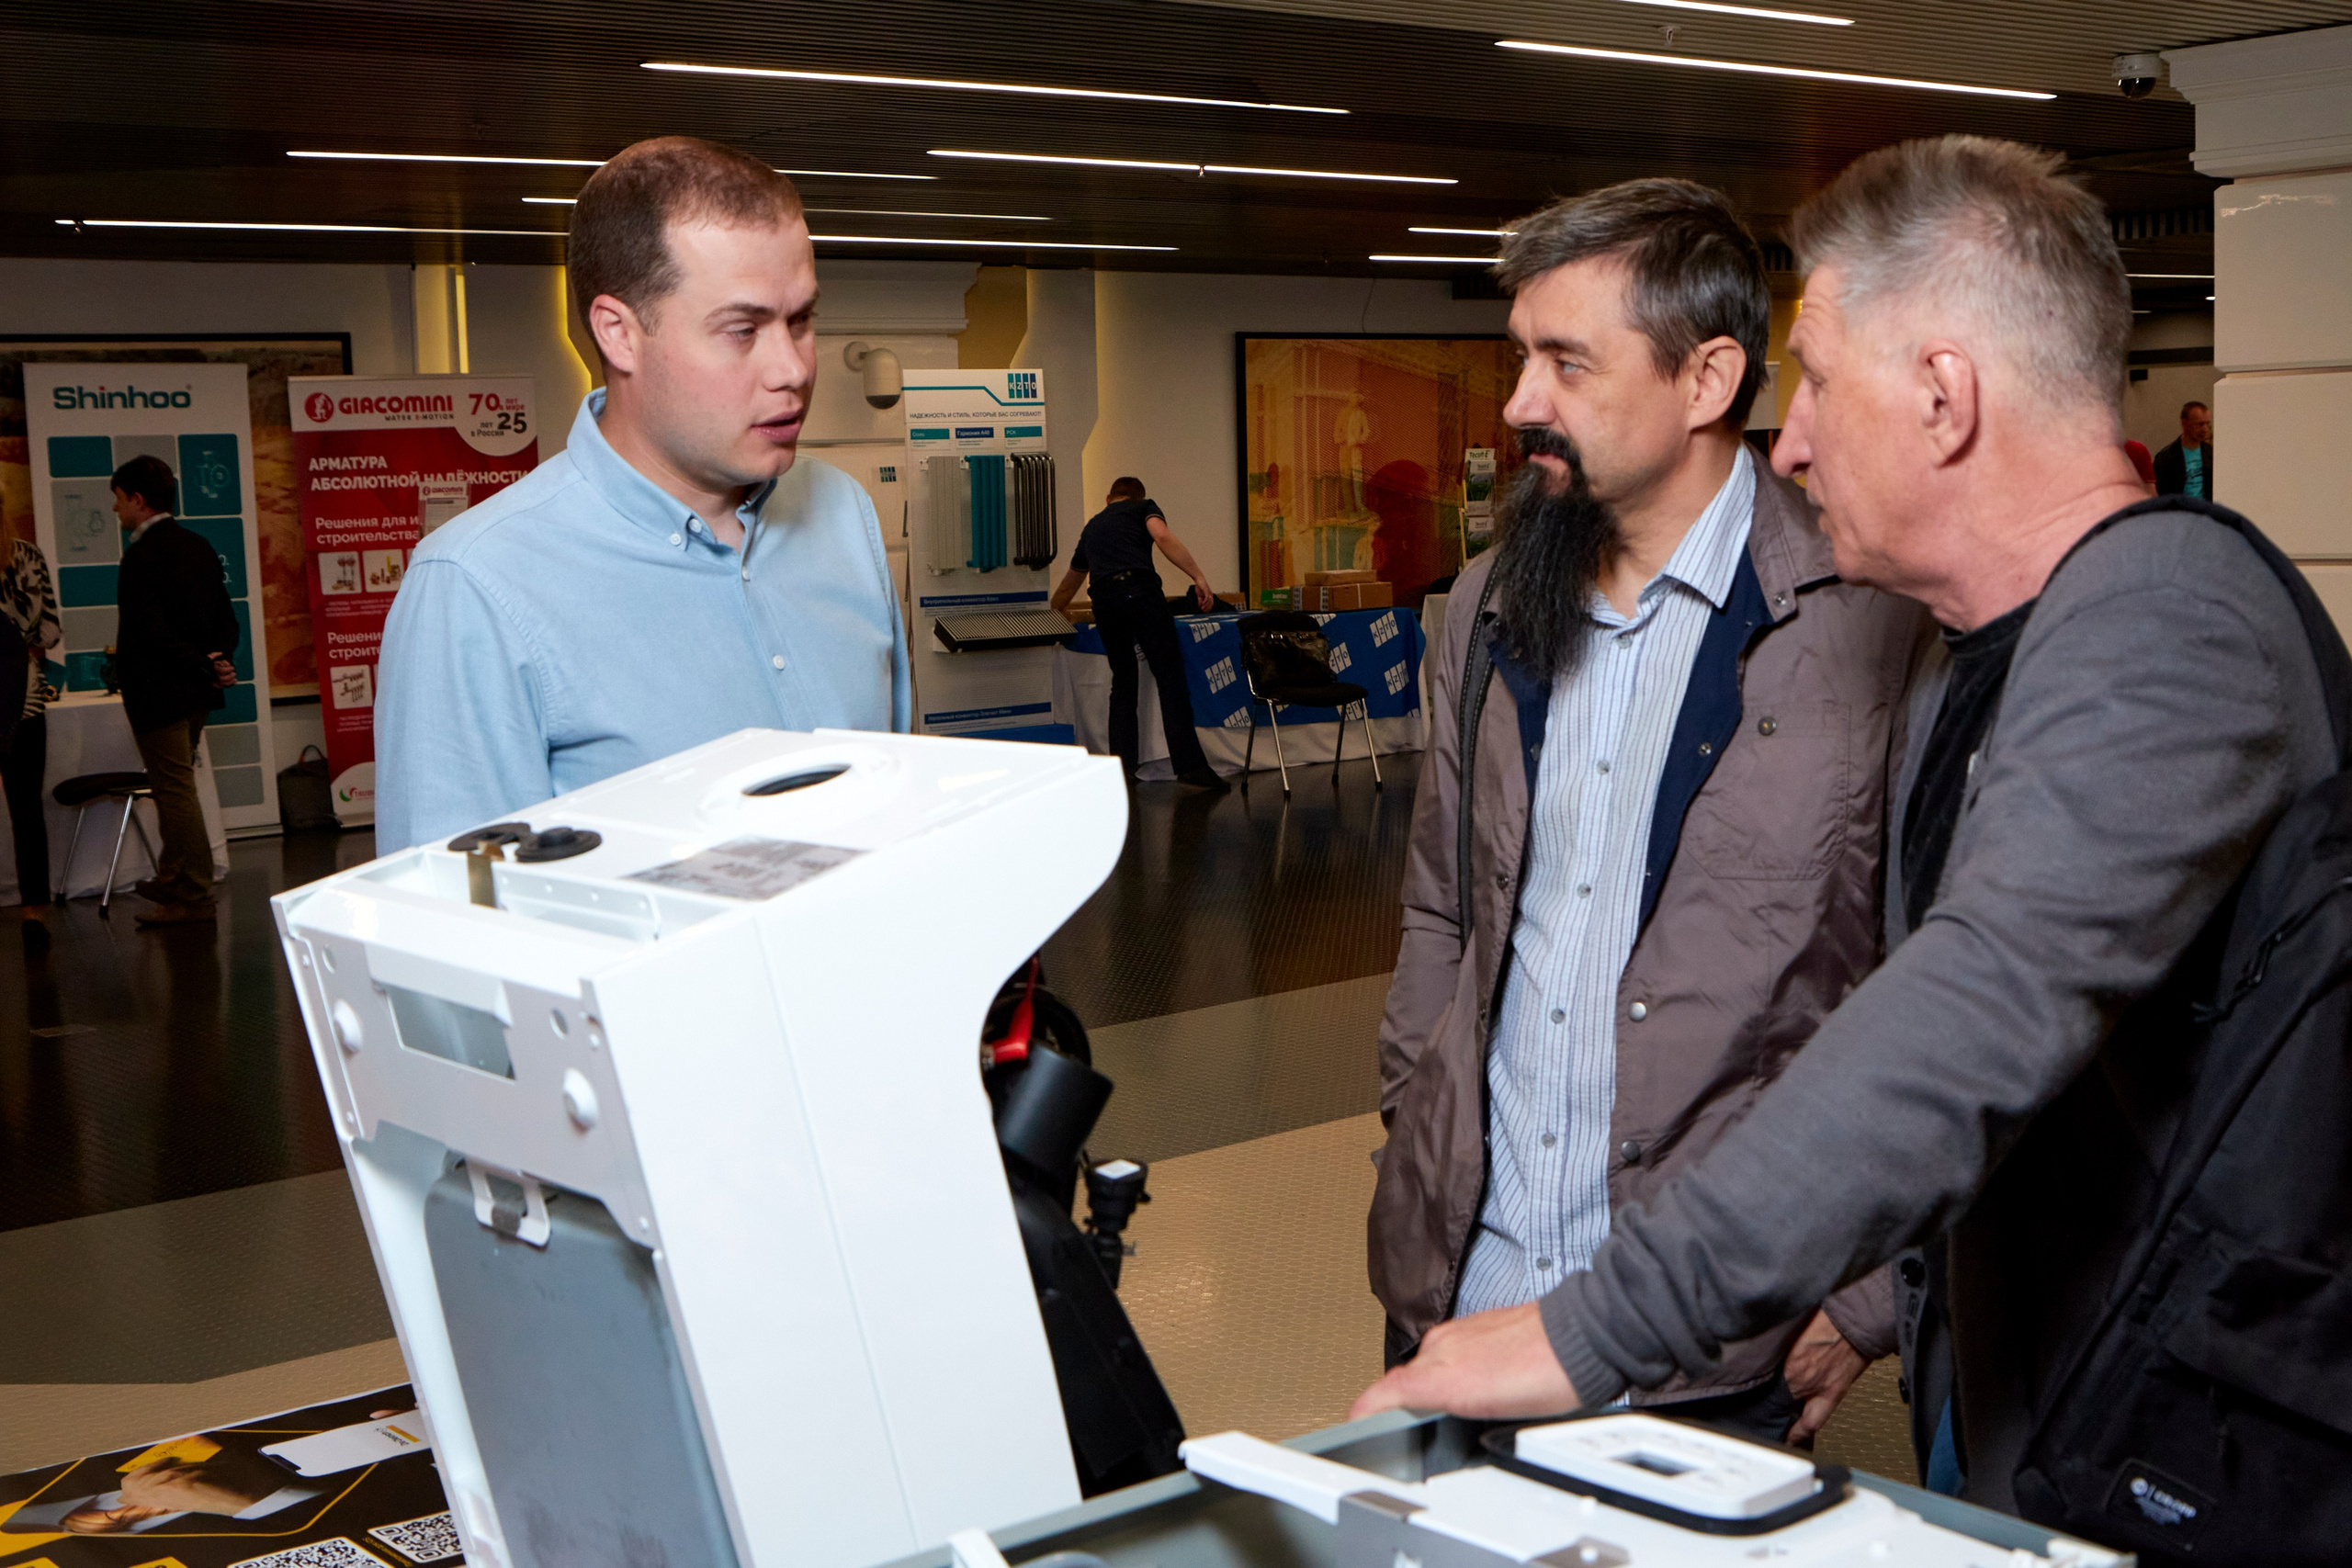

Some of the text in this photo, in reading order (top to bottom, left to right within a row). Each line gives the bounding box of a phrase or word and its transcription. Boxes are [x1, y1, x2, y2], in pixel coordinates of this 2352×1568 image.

[52, 385, 191, 410] Shinhoo
[337, 395, 453, 415] GIACOMINI
[468, 393, 501, 415] 70
[497, 412, 527, 434] 25
[309, 455, 388, 471] АРМАТУРА
[311, 471, 420, 491] АБСОЛЮТНОЙ
[315, 516, 379, 530] Решения
[381, 516, 406, 529] для
